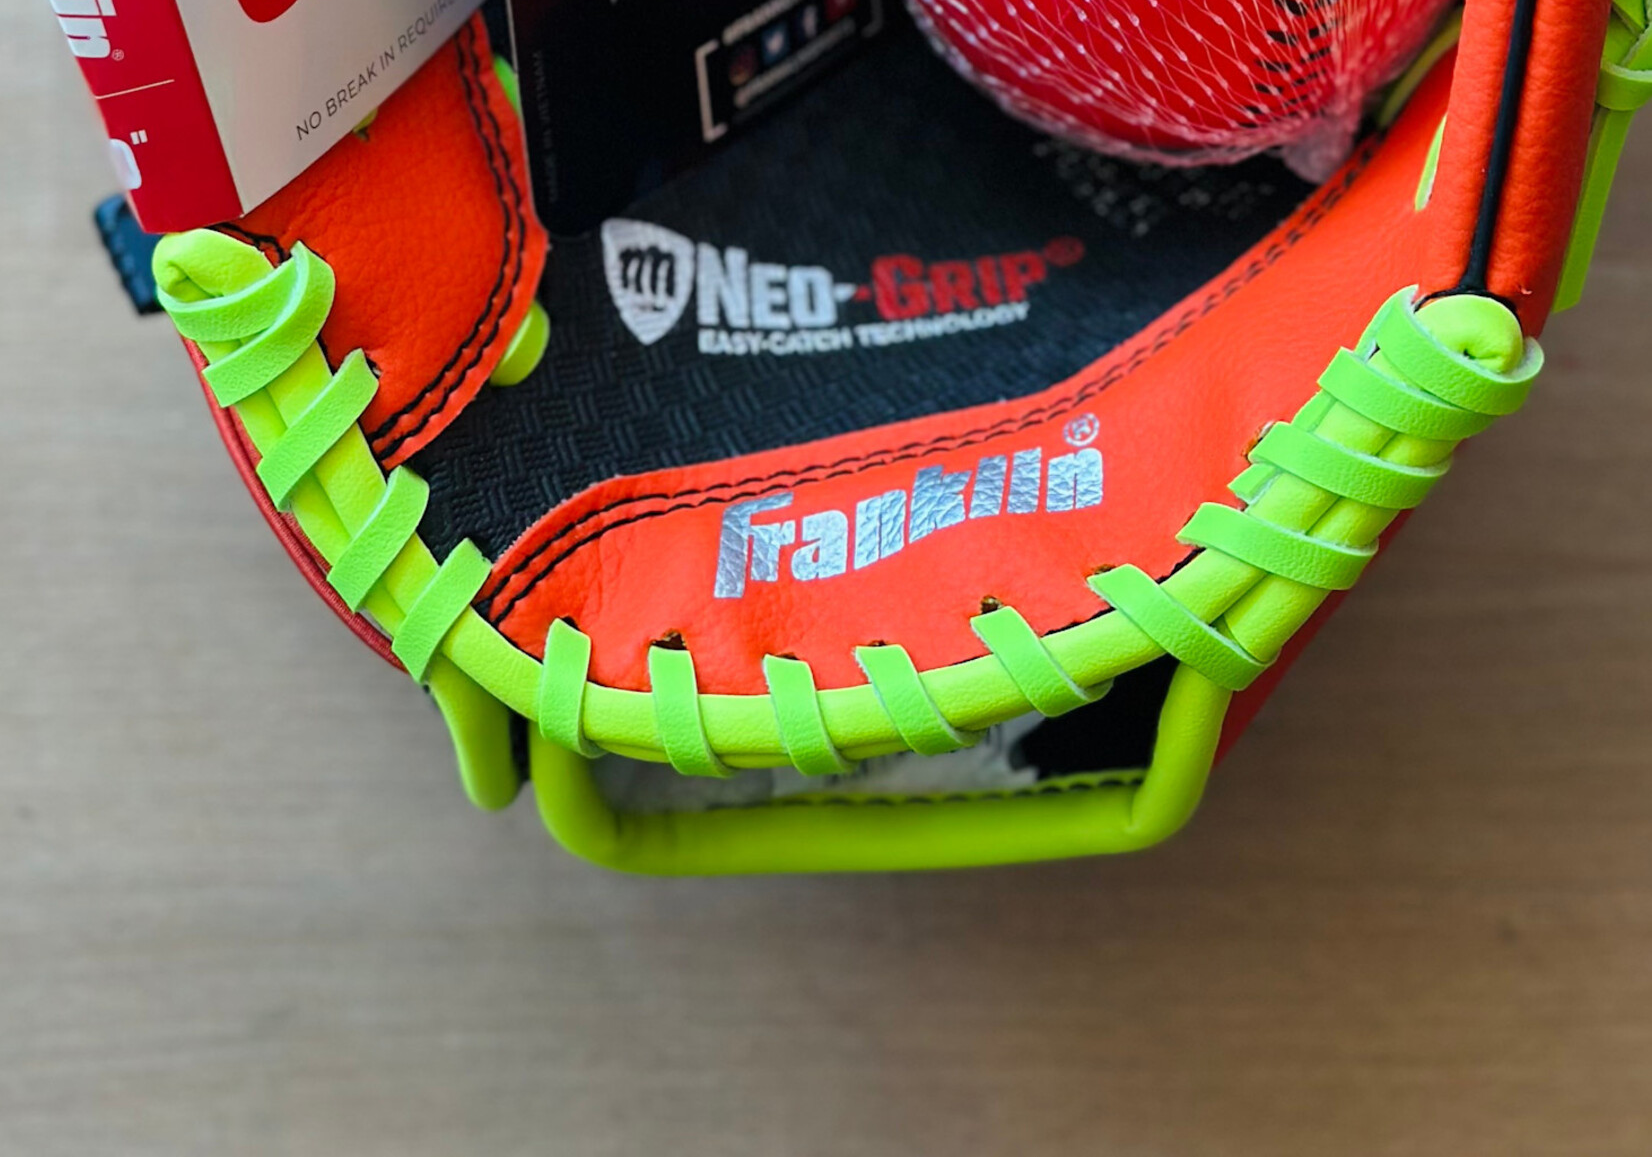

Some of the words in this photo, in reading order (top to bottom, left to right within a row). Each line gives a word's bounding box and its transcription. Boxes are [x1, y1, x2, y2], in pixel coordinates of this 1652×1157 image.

[296, 119, 323, 141] NO
[325, 61, 378, 118] BREAK
[378, 46, 396, 71] IN
[698, 327, 853, 357] EASY-CATCH
[853, 301, 1031, 349] TECHNOLOGY
